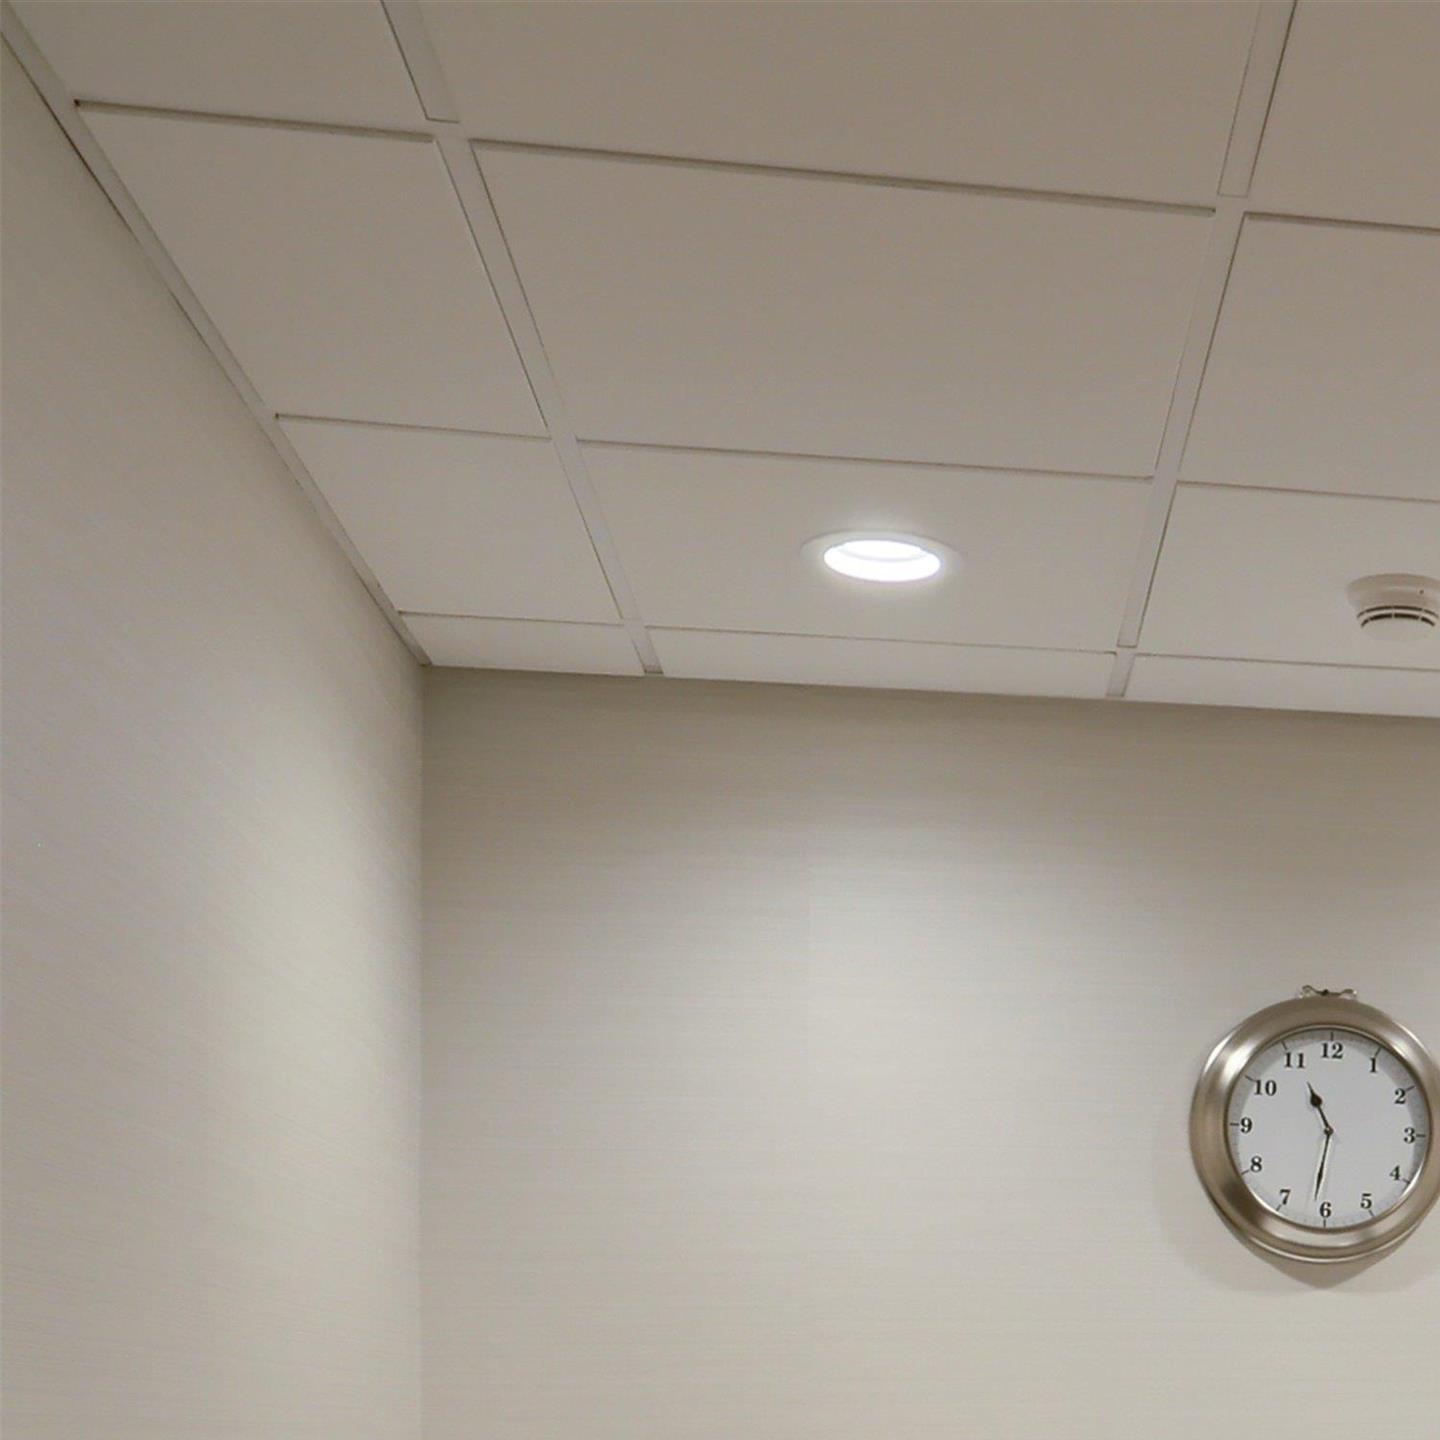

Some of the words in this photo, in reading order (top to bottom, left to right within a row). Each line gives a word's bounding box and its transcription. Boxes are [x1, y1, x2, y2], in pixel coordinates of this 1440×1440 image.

[1320, 1043, 1343, 1060] 12
[1283, 1052, 1305, 1069] 11
[1369, 1057, 1377, 1074] 1
[1254, 1080, 1277, 1097] 10
[1394, 1088, 1406, 1105] 2
[1240, 1117, 1253, 1133] 9
[1403, 1127, 1416, 1144] 3
[1250, 1156, 1263, 1172] 8
[1389, 1165, 1401, 1181] 4
[1279, 1188, 1291, 1206] 7
[1360, 1193, 1373, 1210] 5
[1319, 1201, 1332, 1218] 6
